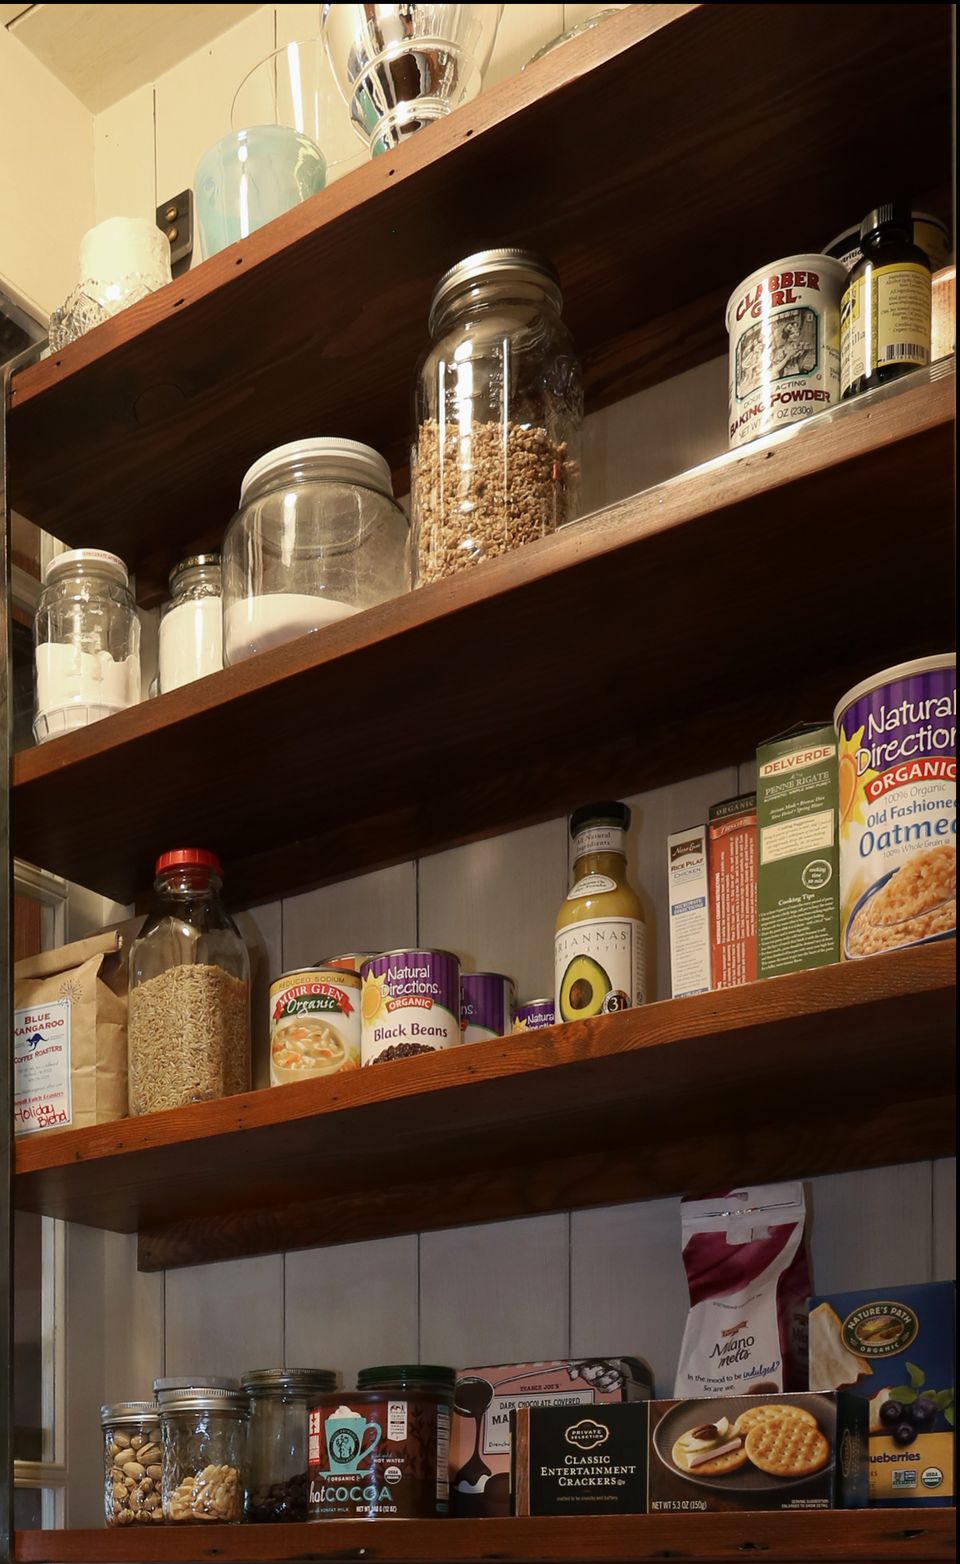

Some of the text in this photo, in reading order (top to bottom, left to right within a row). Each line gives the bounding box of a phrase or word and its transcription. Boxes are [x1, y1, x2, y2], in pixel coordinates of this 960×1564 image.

[751, 288, 797, 318] GRL
[775, 380, 806, 391] ACTING
[770, 389, 830, 408] POWDER
[868, 690, 957, 740] Natural
[763, 746, 832, 775] DELVERDE
[765, 770, 830, 796] PENNE RIGATE
[909, 783, 946, 798] Organic
[716, 800, 754, 816] ORGANIC
[867, 809, 887, 829] Old
[556, 930, 627, 953] RIANNAS
[388, 964, 430, 981] Natural
[279, 984, 345, 1007] MUIR GLEN
[380, 979, 439, 998] Directions
[287, 996, 335, 1019] Organic
[388, 998, 431, 1010] ORGANIC
[24, 1013, 51, 1025] BLUE
[527, 1013, 555, 1025] Natura
[374, 1022, 448, 1042] Black Beans
[14, 1104, 56, 1123] Holiday
[38, 1109, 68, 1128] Blend
[847, 1306, 913, 1331] NATURE'S PATH
[860, 1342, 900, 1354] ORGANIC
[695, 1374, 706, 1382] the
[707, 1375, 726, 1384] mood
[499, 1397, 581, 1410] DARK CHOCOLATE COVERED
[564, 1455, 611, 1465] CLASSIC
[870, 1451, 921, 1464] ueberries
[541, 1465, 637, 1477] ENTERTAINMENT
[558, 1476, 617, 1487] CRACKERS
[309, 1481, 394, 1504] hot COCOA
[652, 1500, 708, 1511] NET WT 5.3 OZ (150g)
